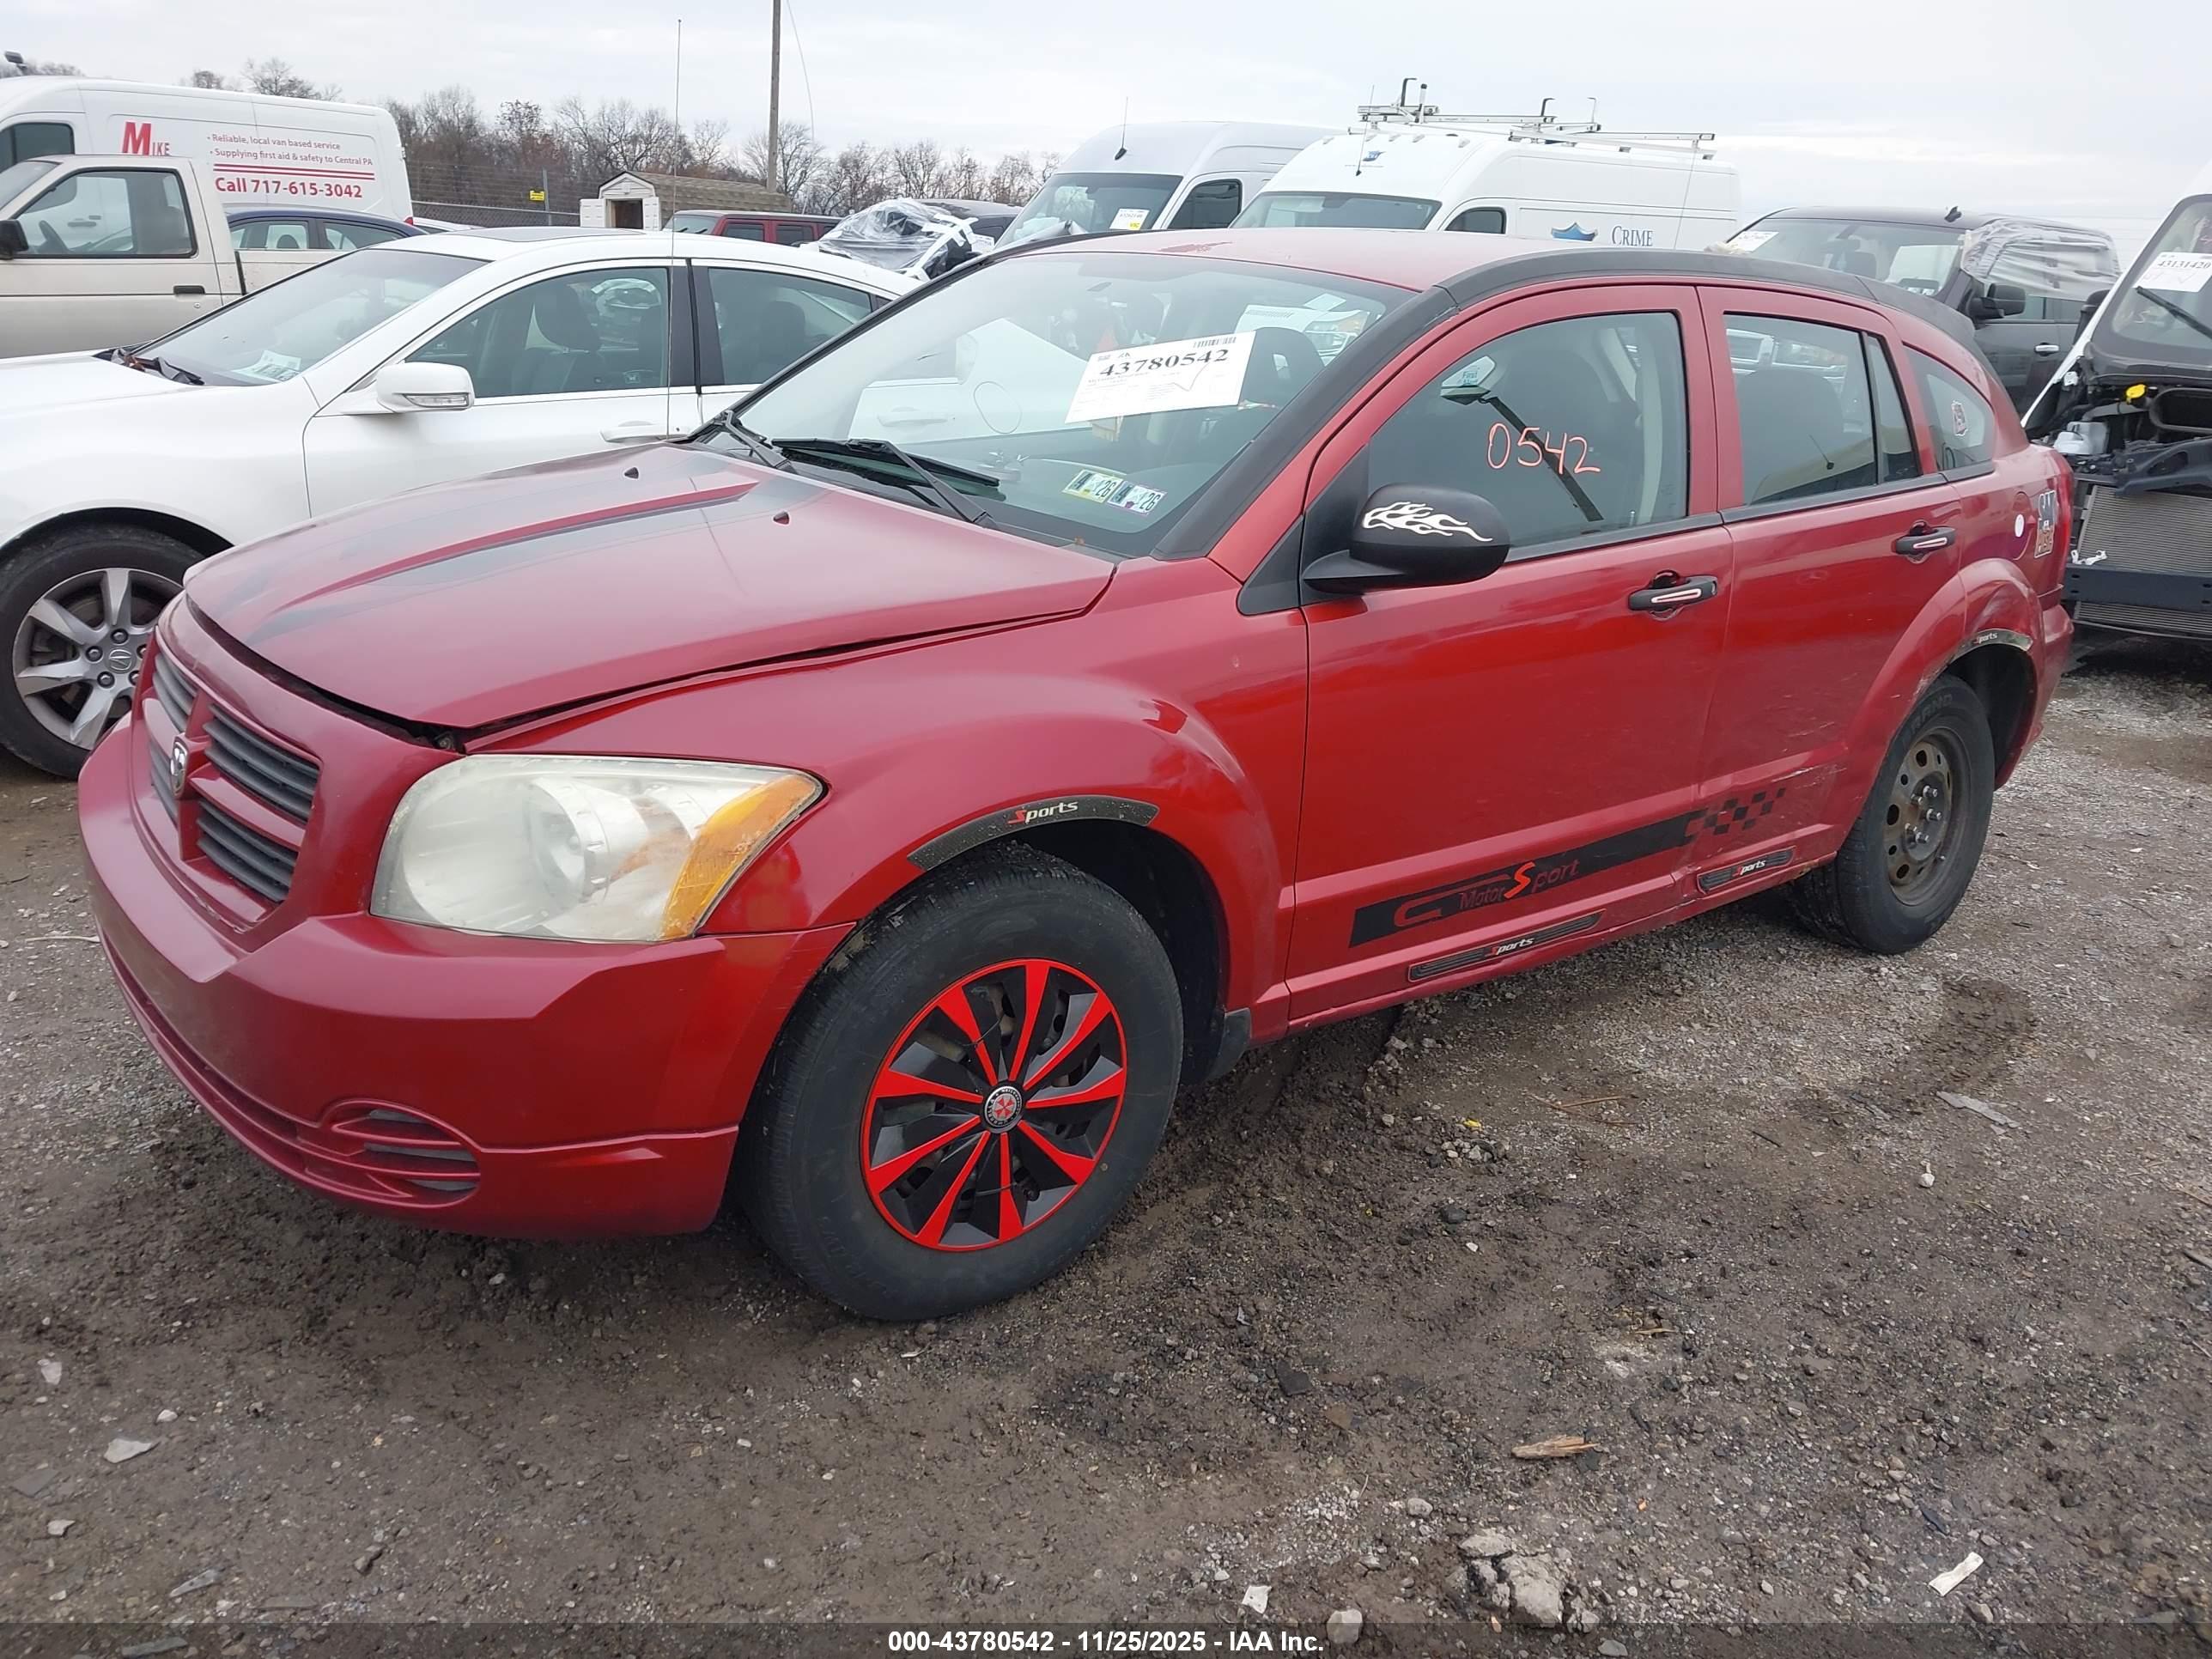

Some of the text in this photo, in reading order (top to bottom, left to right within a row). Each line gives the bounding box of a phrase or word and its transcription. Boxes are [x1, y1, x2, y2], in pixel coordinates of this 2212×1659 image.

[212, 133, 248, 144] Reliable,
[250, 136, 270, 145] local
[288, 138, 312, 148] based
[313, 141, 341, 150] service
[215, 148, 258, 160] Supplying
[259, 150, 276, 160] first
[277, 151, 290, 161] aid
[292, 152, 298, 161] &
[300, 153, 324, 164] safety
[325, 155, 333, 163] to
[334, 155, 362, 165] Central
[215, 177, 363, 198] Call 717-615-3042
[1099, 349, 1229, 377] 43780542
[1487, 422, 1601, 474] 0542
[1095, 480, 1116, 498] 26
[1139, 492, 1161, 512] 26
[1007, 800, 1079, 825] Sports
